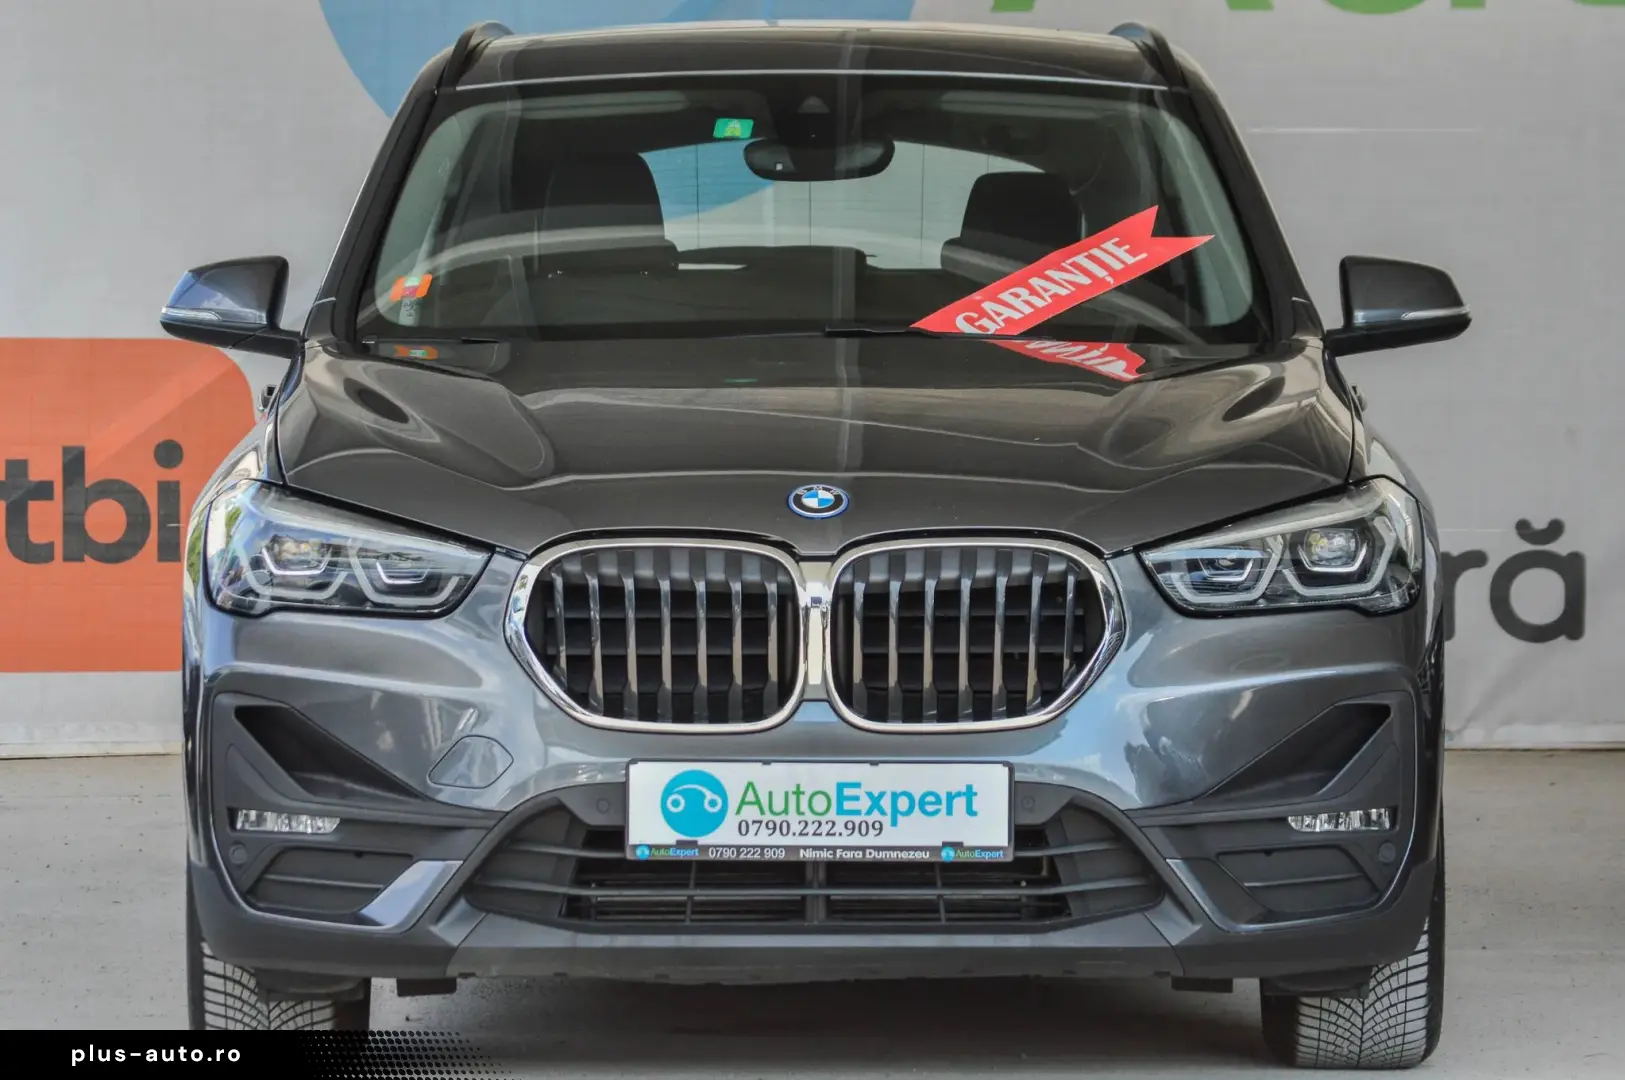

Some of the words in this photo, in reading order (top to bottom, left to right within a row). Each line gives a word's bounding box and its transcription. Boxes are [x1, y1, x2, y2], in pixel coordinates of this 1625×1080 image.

[0, 439, 184, 565] tbi
[735, 781, 978, 827] AutoExpert
[737, 819, 884, 838] 0790.222.909
[650, 846, 699, 858] AutoExpert
[708, 847, 736, 859] 0790
[739, 847, 761, 859] 222
[764, 847, 785, 859] 909
[800, 847, 833, 859] Nimic
[836, 847, 863, 859] Fara
[865, 848, 930, 860] Dumnezeu
[956, 848, 1004, 860] AutoExpert
